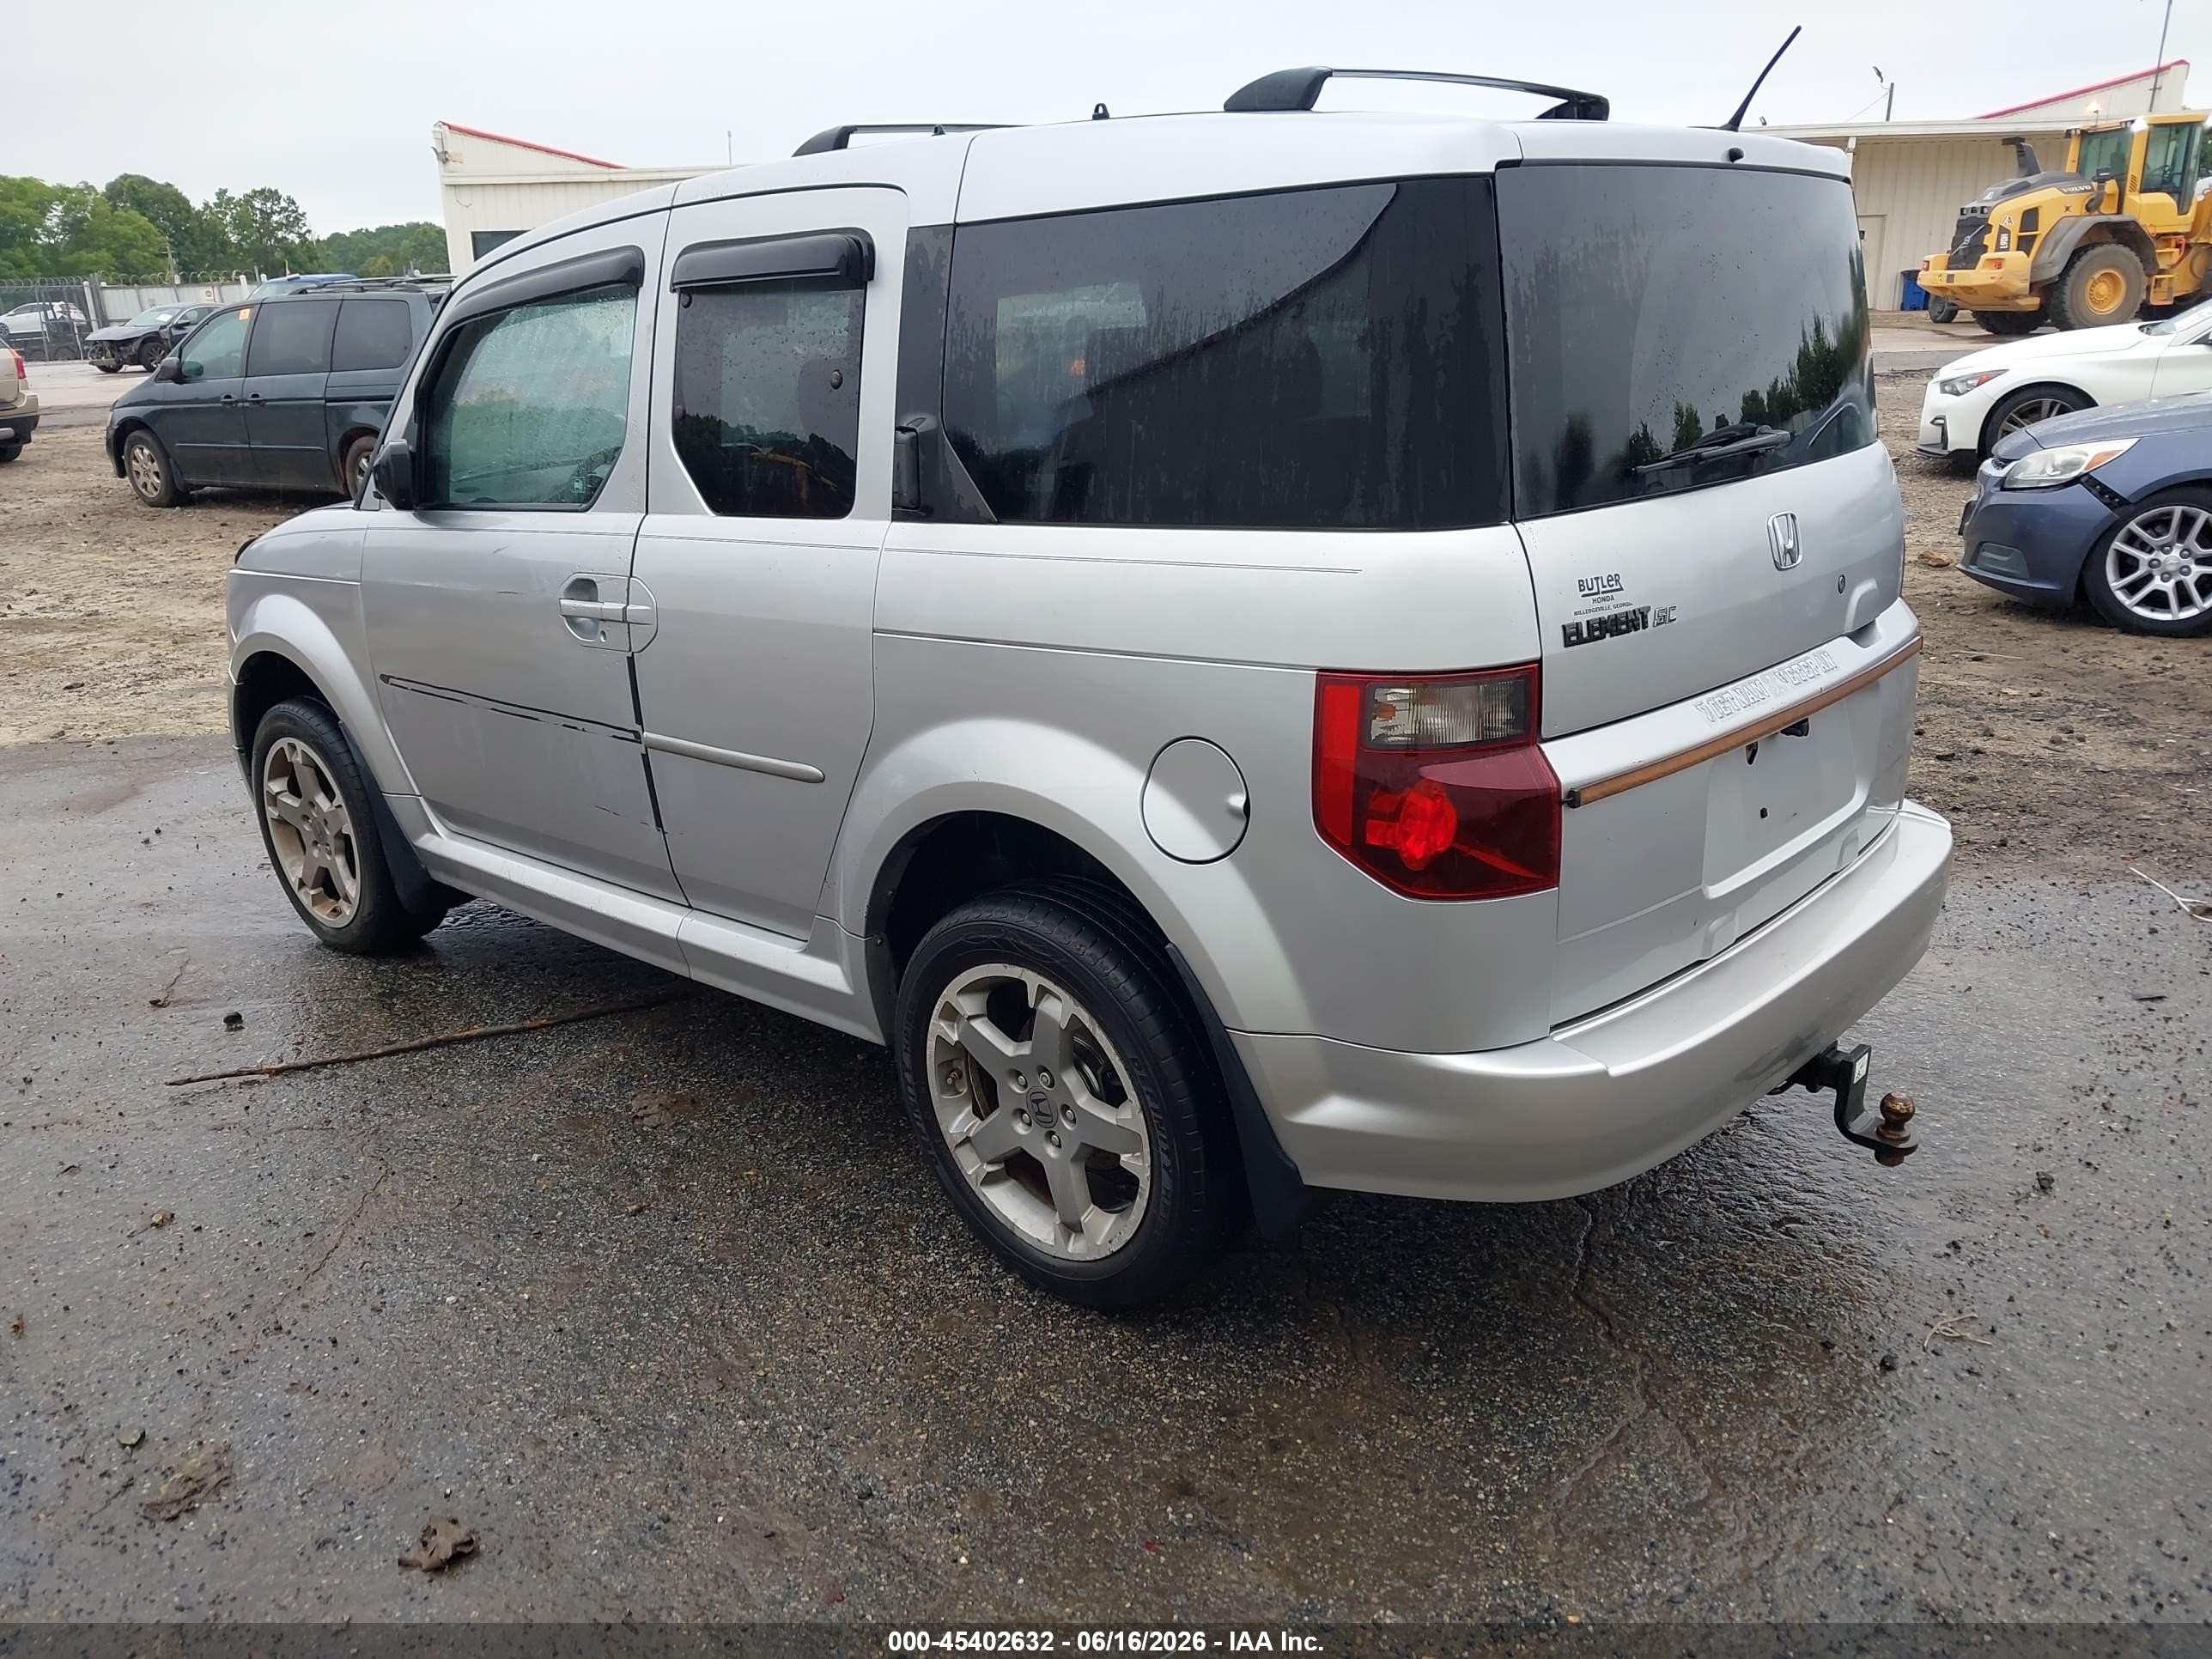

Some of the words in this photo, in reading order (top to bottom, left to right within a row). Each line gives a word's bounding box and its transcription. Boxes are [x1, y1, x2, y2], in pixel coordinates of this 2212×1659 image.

[1592, 594, 1615, 604] HONDA
[1561, 605, 1651, 648] ELEMENT
[1652, 604, 1677, 628] SC
